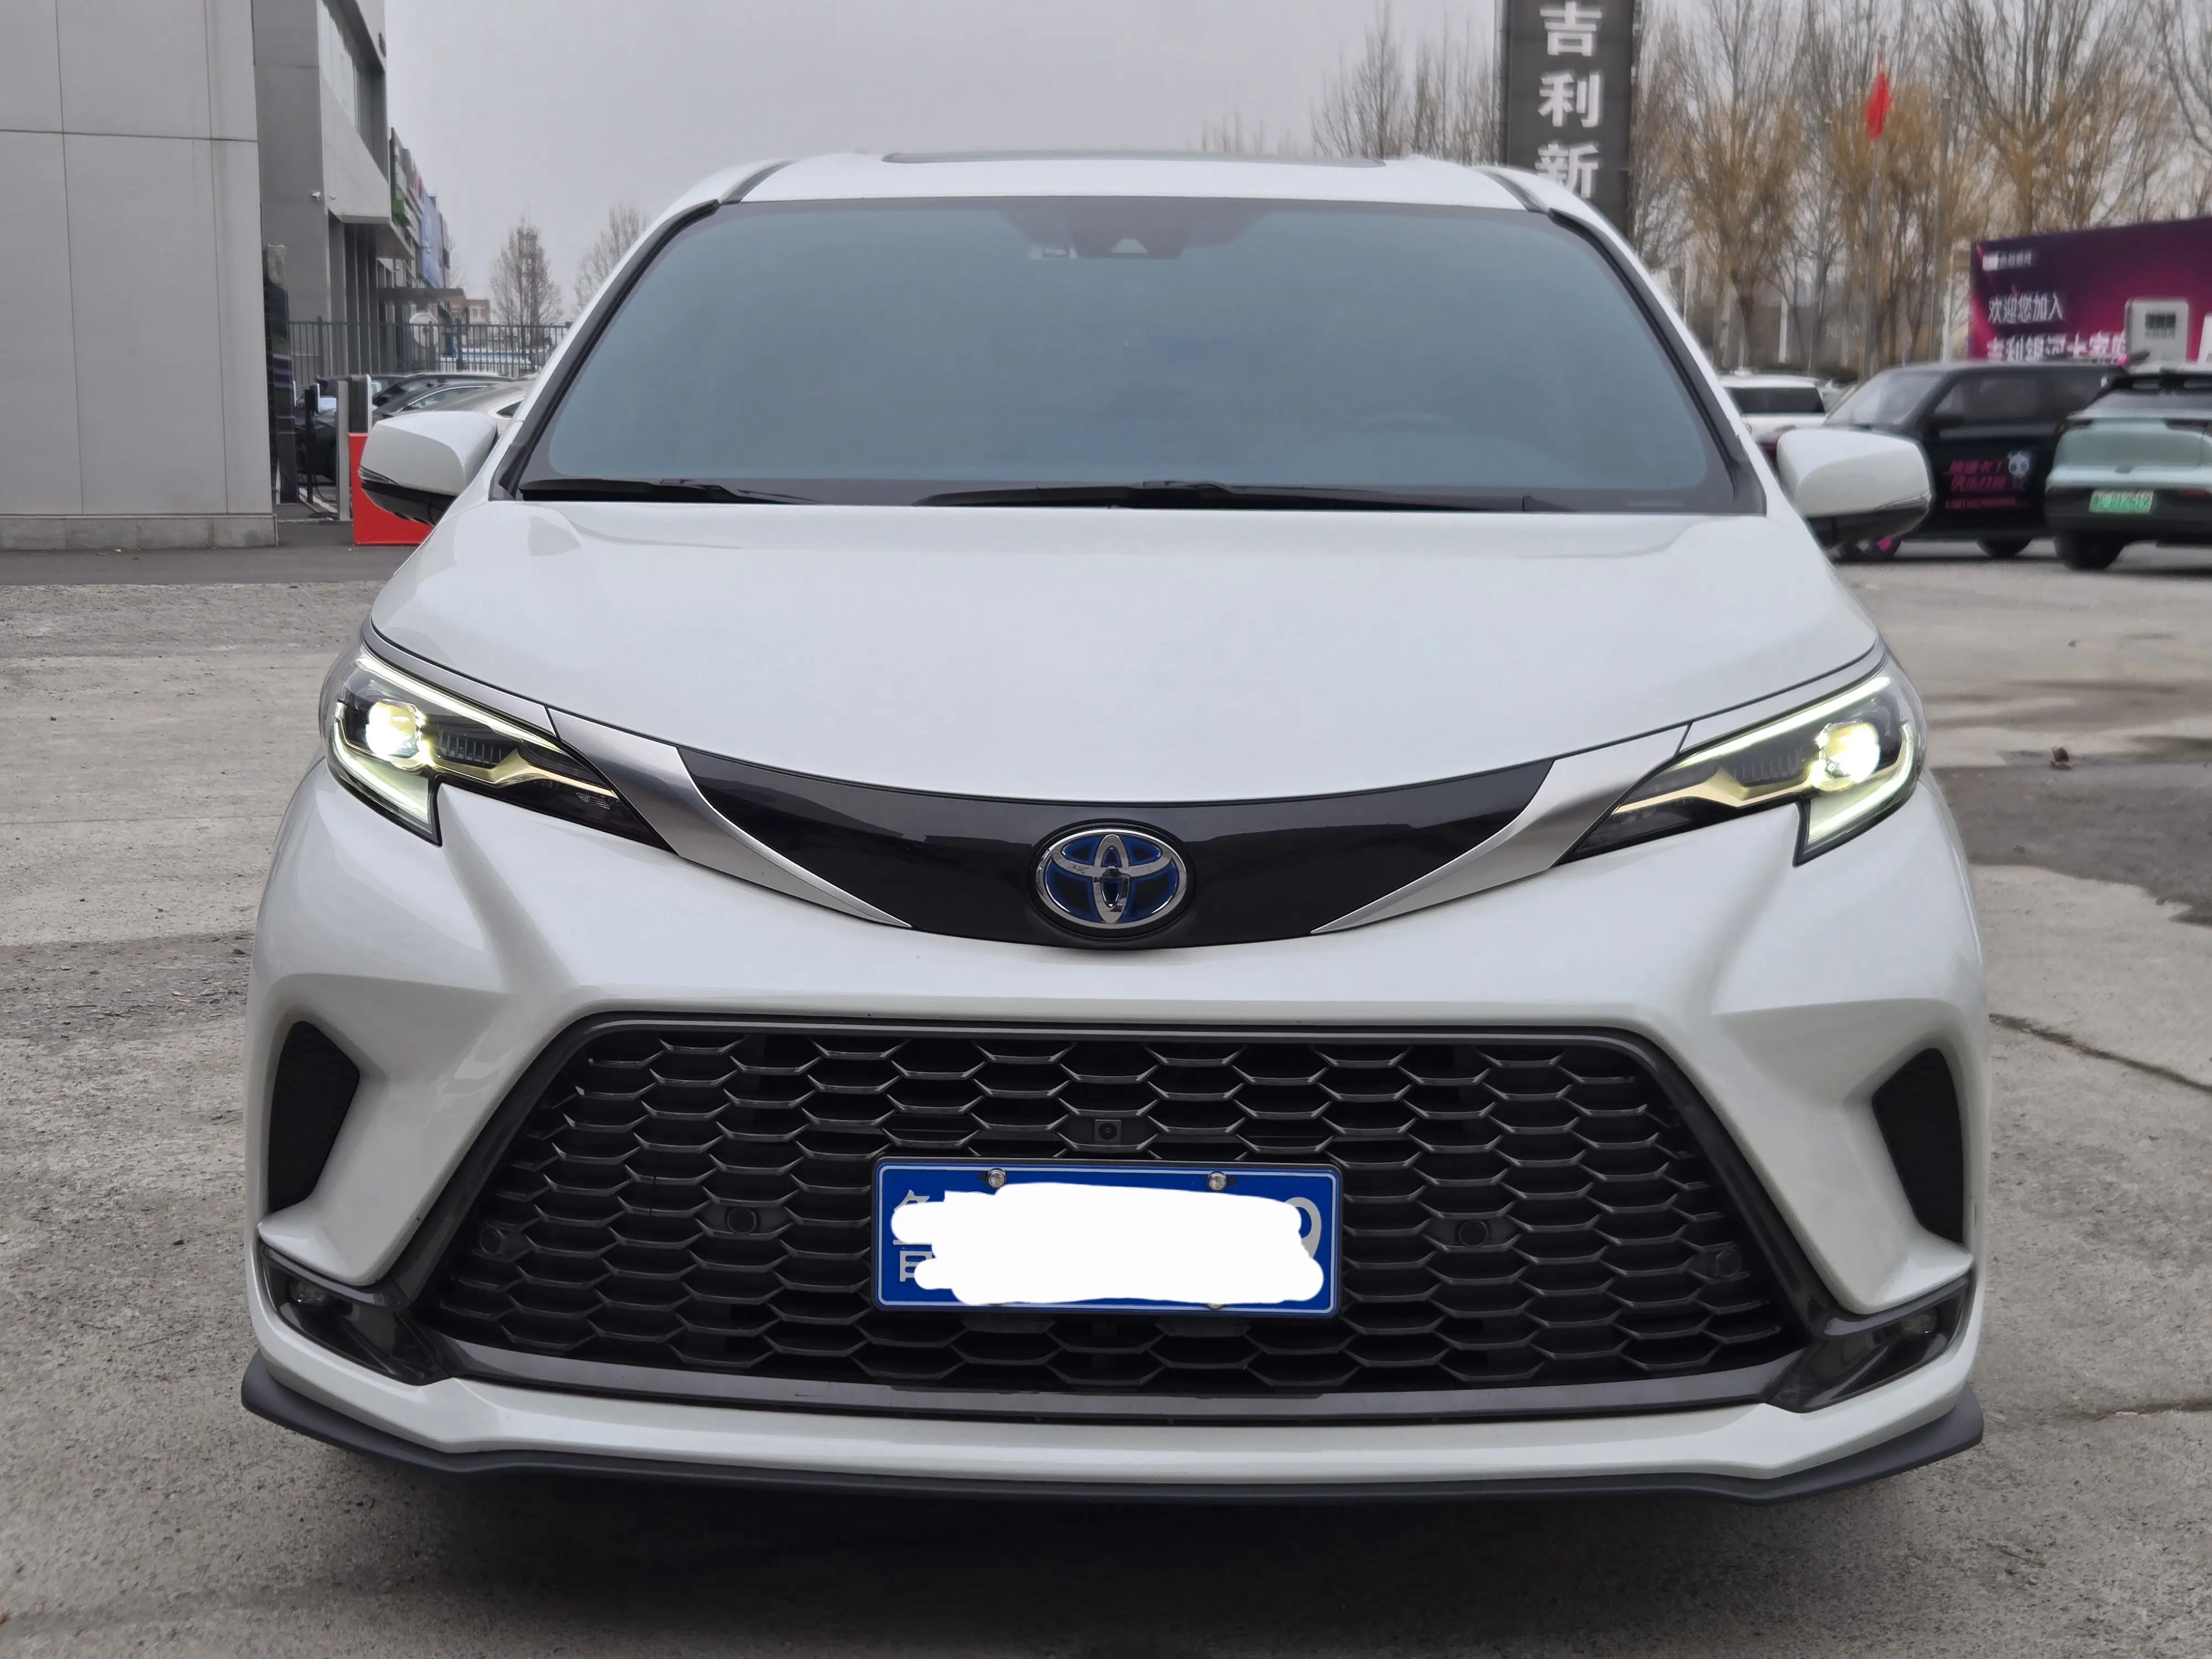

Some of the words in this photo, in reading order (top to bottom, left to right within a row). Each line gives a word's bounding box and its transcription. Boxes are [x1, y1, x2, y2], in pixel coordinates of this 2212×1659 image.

[1536, 1, 1601, 199] 吉利新
[1989, 291, 2063, 324] 欢迎您加入
